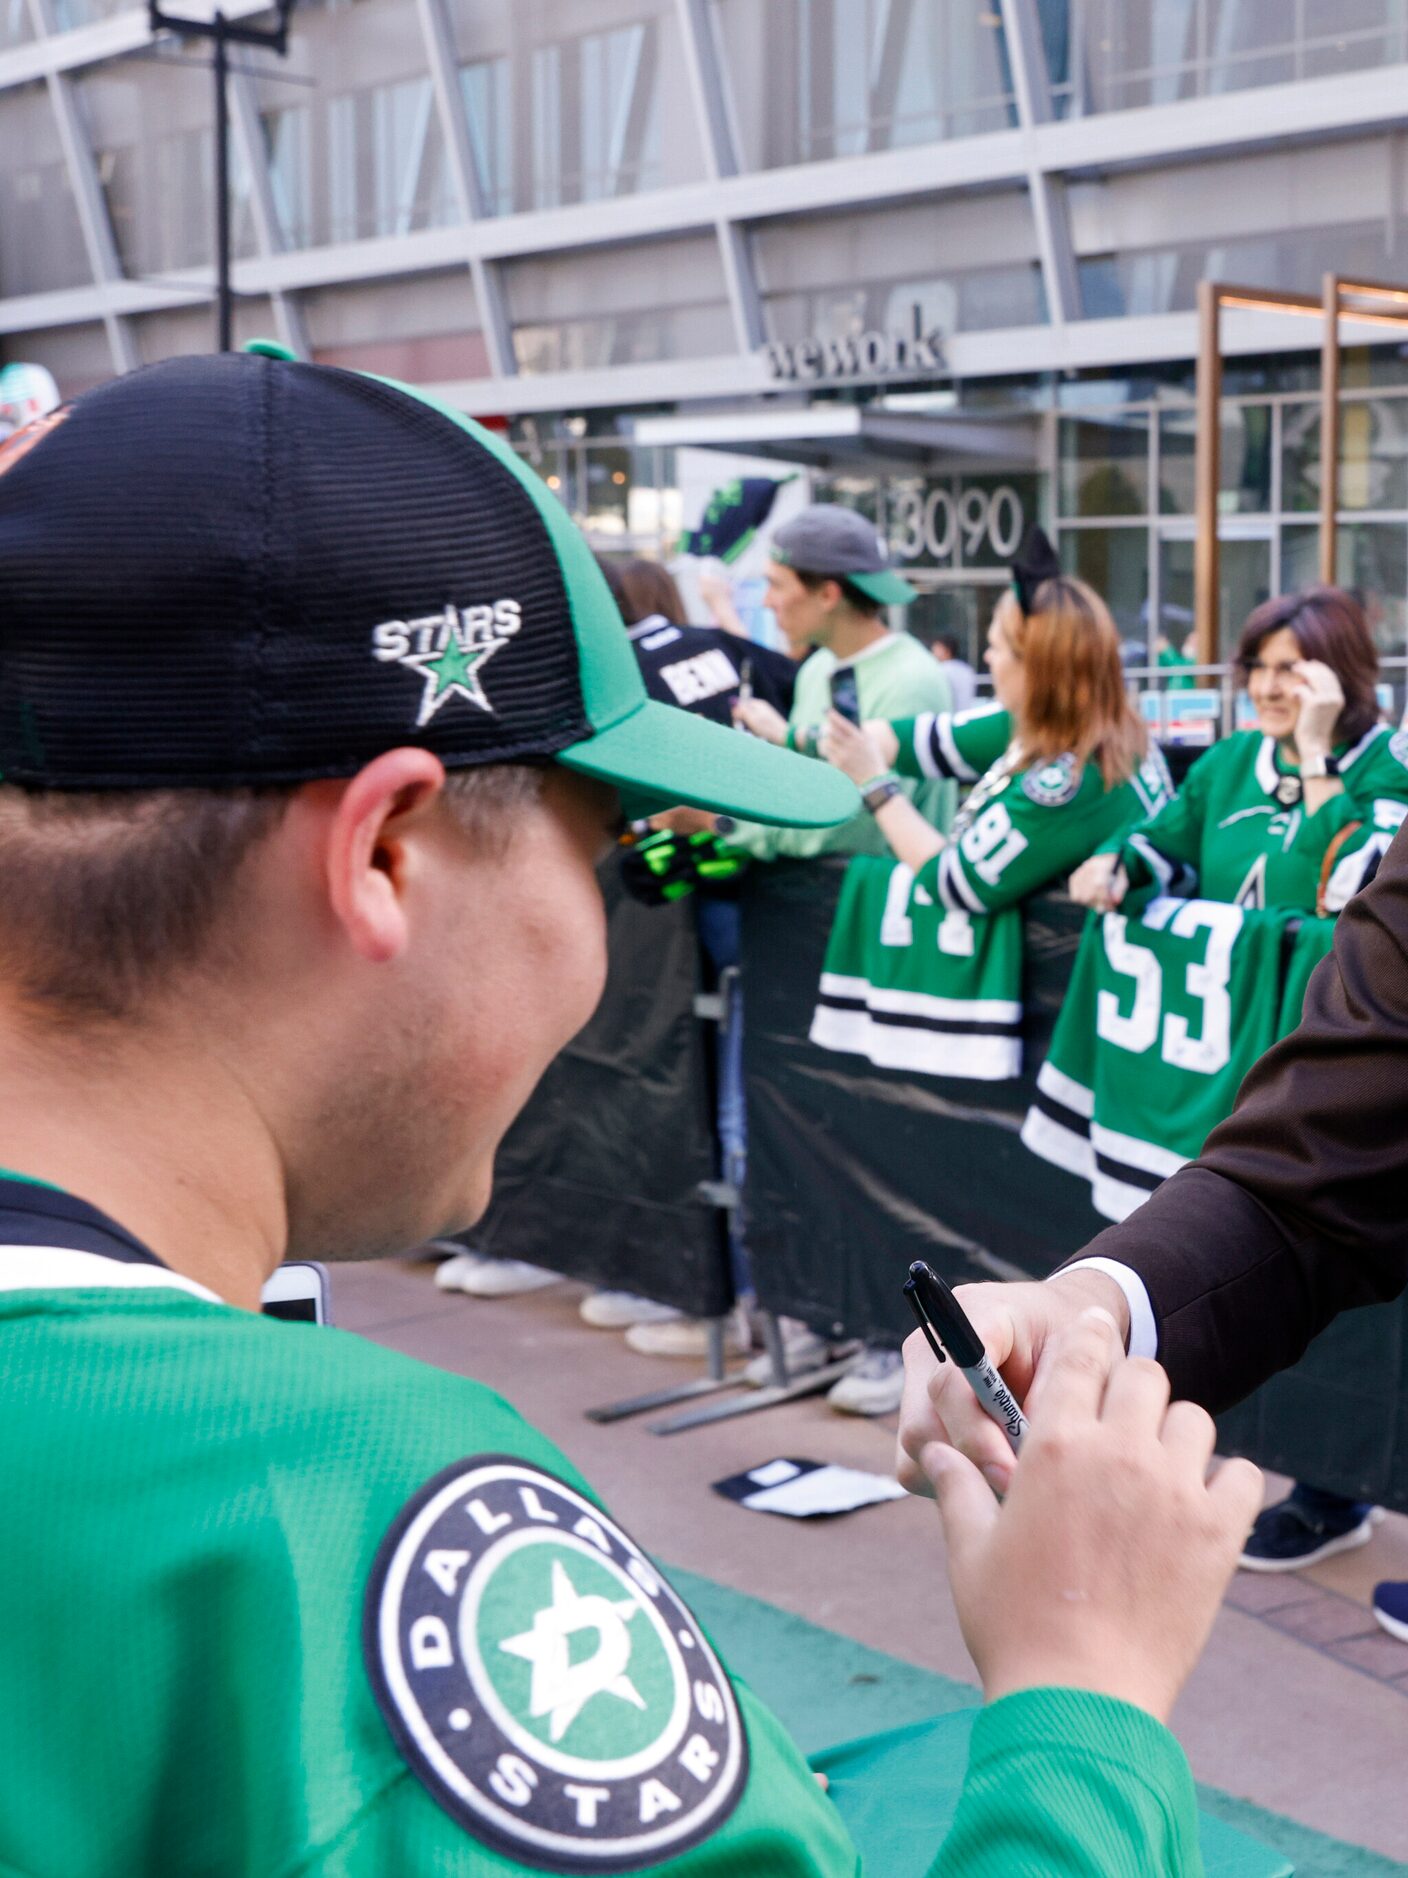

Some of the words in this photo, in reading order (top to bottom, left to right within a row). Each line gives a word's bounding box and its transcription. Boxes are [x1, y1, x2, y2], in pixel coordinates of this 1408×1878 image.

[372, 598, 522, 662] STARS
[1097, 898, 1244, 1075] 53
[408, 1486, 662, 1671] DALLAS
[488, 1680, 726, 1828] STARS
